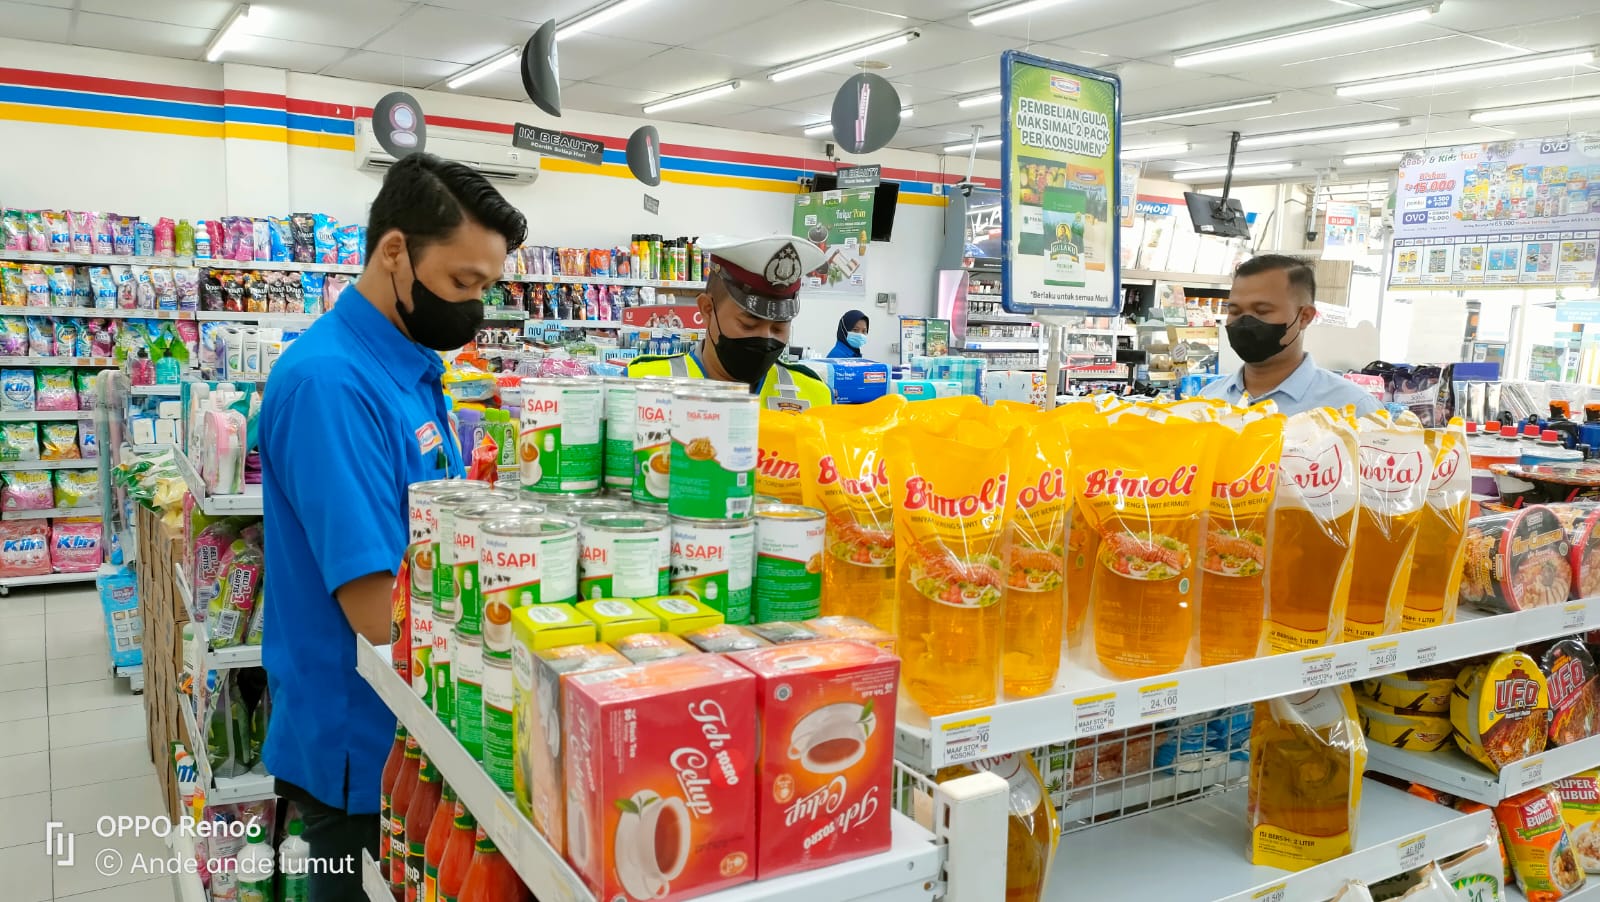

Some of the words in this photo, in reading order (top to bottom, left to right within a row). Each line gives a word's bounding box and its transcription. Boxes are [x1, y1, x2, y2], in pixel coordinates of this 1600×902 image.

[1020, 99, 1080, 121] PEMBELIAN
[1081, 111, 1107, 127] GULA
[1017, 114, 1074, 136] MAKSIMAL
[1076, 124, 1082, 137] 2
[1084, 126, 1109, 142] PACK
[1021, 130, 1042, 145] PER
[518, 126, 535, 140] IN
[540, 132, 599, 154] BEAUTY
[1541, 142, 1568, 153] OVO
[1405, 213, 1426, 223] OVO
[1052, 243, 1077, 255] GULAKU
[1056, 292, 1074, 301] untuk
[1075, 294, 1094, 302] semua
[527, 398, 559, 414] SAPI
[636, 405, 665, 422] TIGA
[1084, 464, 1198, 499] Bimoli
[903, 473, 1008, 518] Bimoli
[3, 538, 45, 552] Klin
[56, 534, 96, 549] Klin
[202, 545, 210, 571] GRATIS
[496, 551, 537, 568] SAPI
[685, 544, 722, 560] SAPI
[232, 568, 243, 595] GRATIS
[1422, 616, 1436, 624] LITER
[1150, 695, 1178, 710] 24.100
[687, 698, 732, 750] Teh
[715, 749, 740, 786] SOSRO
[669, 747, 713, 817] Celup
[784, 775, 847, 828] Celup
[838, 785, 879, 835] Teh
[1524, 797, 1549, 816] SUPER
[1526, 808, 1555, 828] BUBUR
[803, 820, 836, 850] SOSRO
